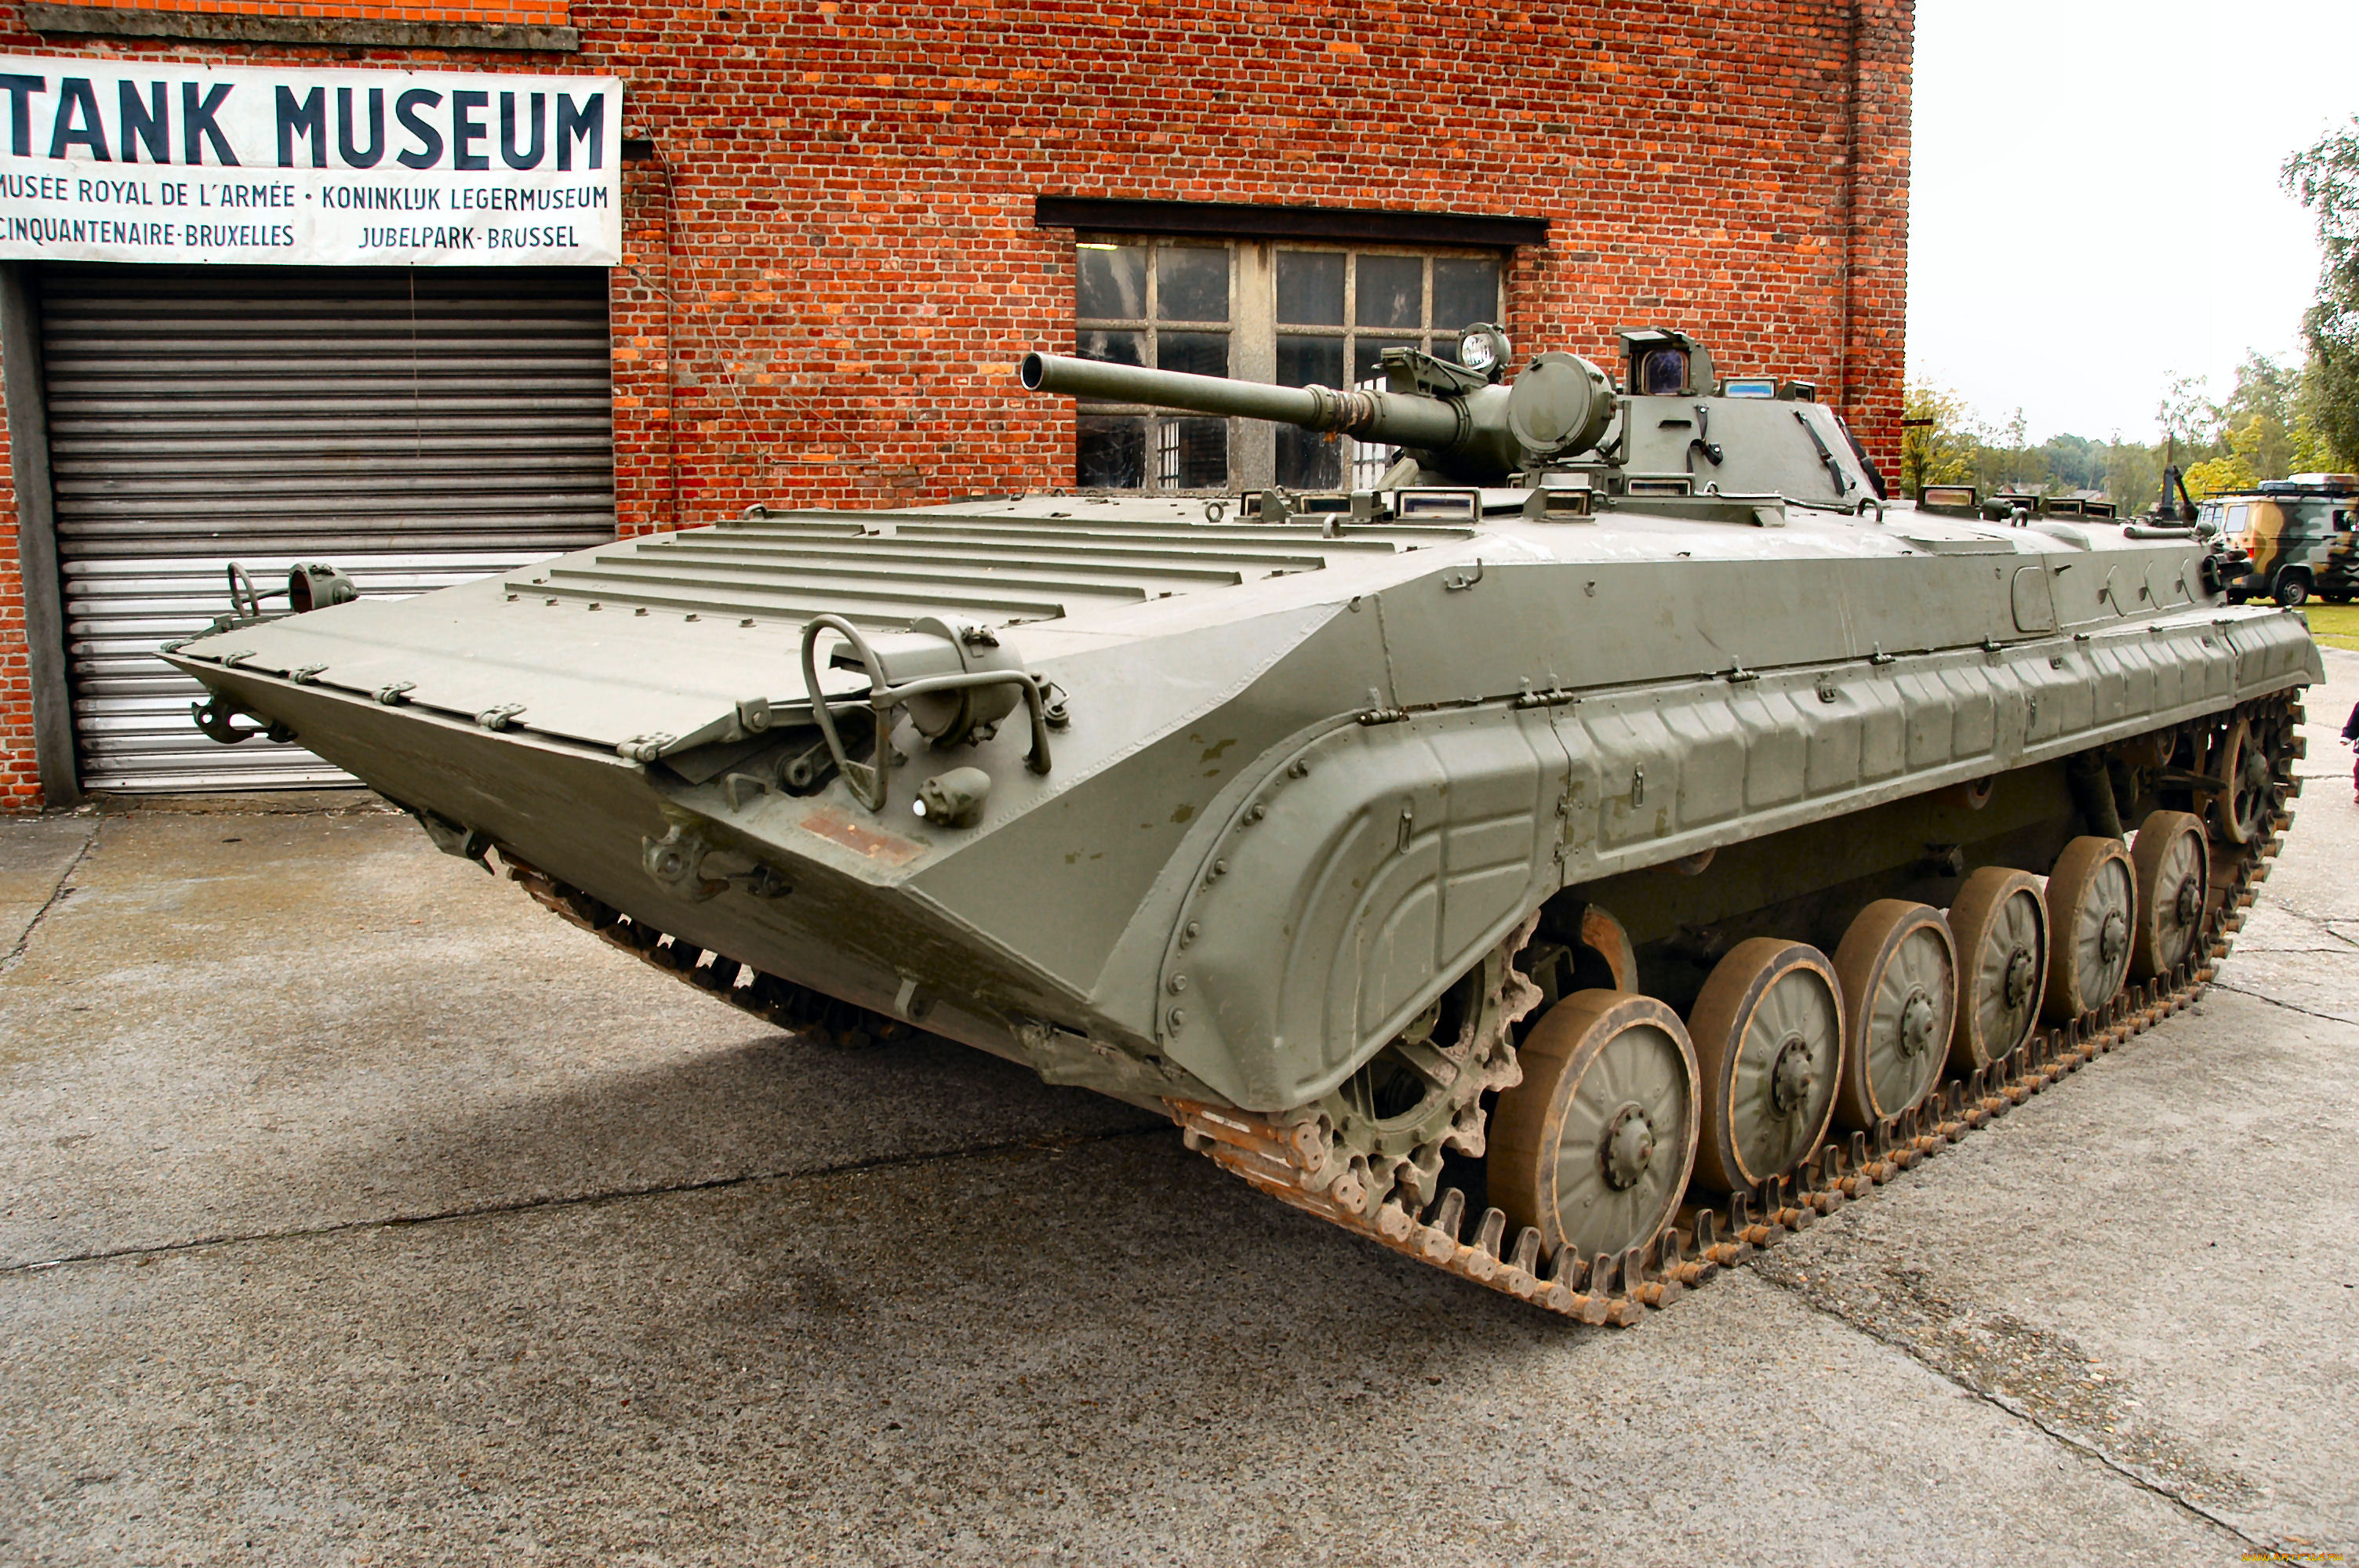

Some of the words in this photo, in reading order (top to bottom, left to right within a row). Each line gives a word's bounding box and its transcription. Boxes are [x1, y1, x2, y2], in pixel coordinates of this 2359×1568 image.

[0, 74, 242, 166] TANK
[275, 85, 605, 171] MUSEUM
[79, 179, 153, 205] ROYAL
[162, 183, 188, 206] DE
[322, 186, 441, 210] KONINKLIJK
[451, 186, 608, 211] LEGERMUSEUM
